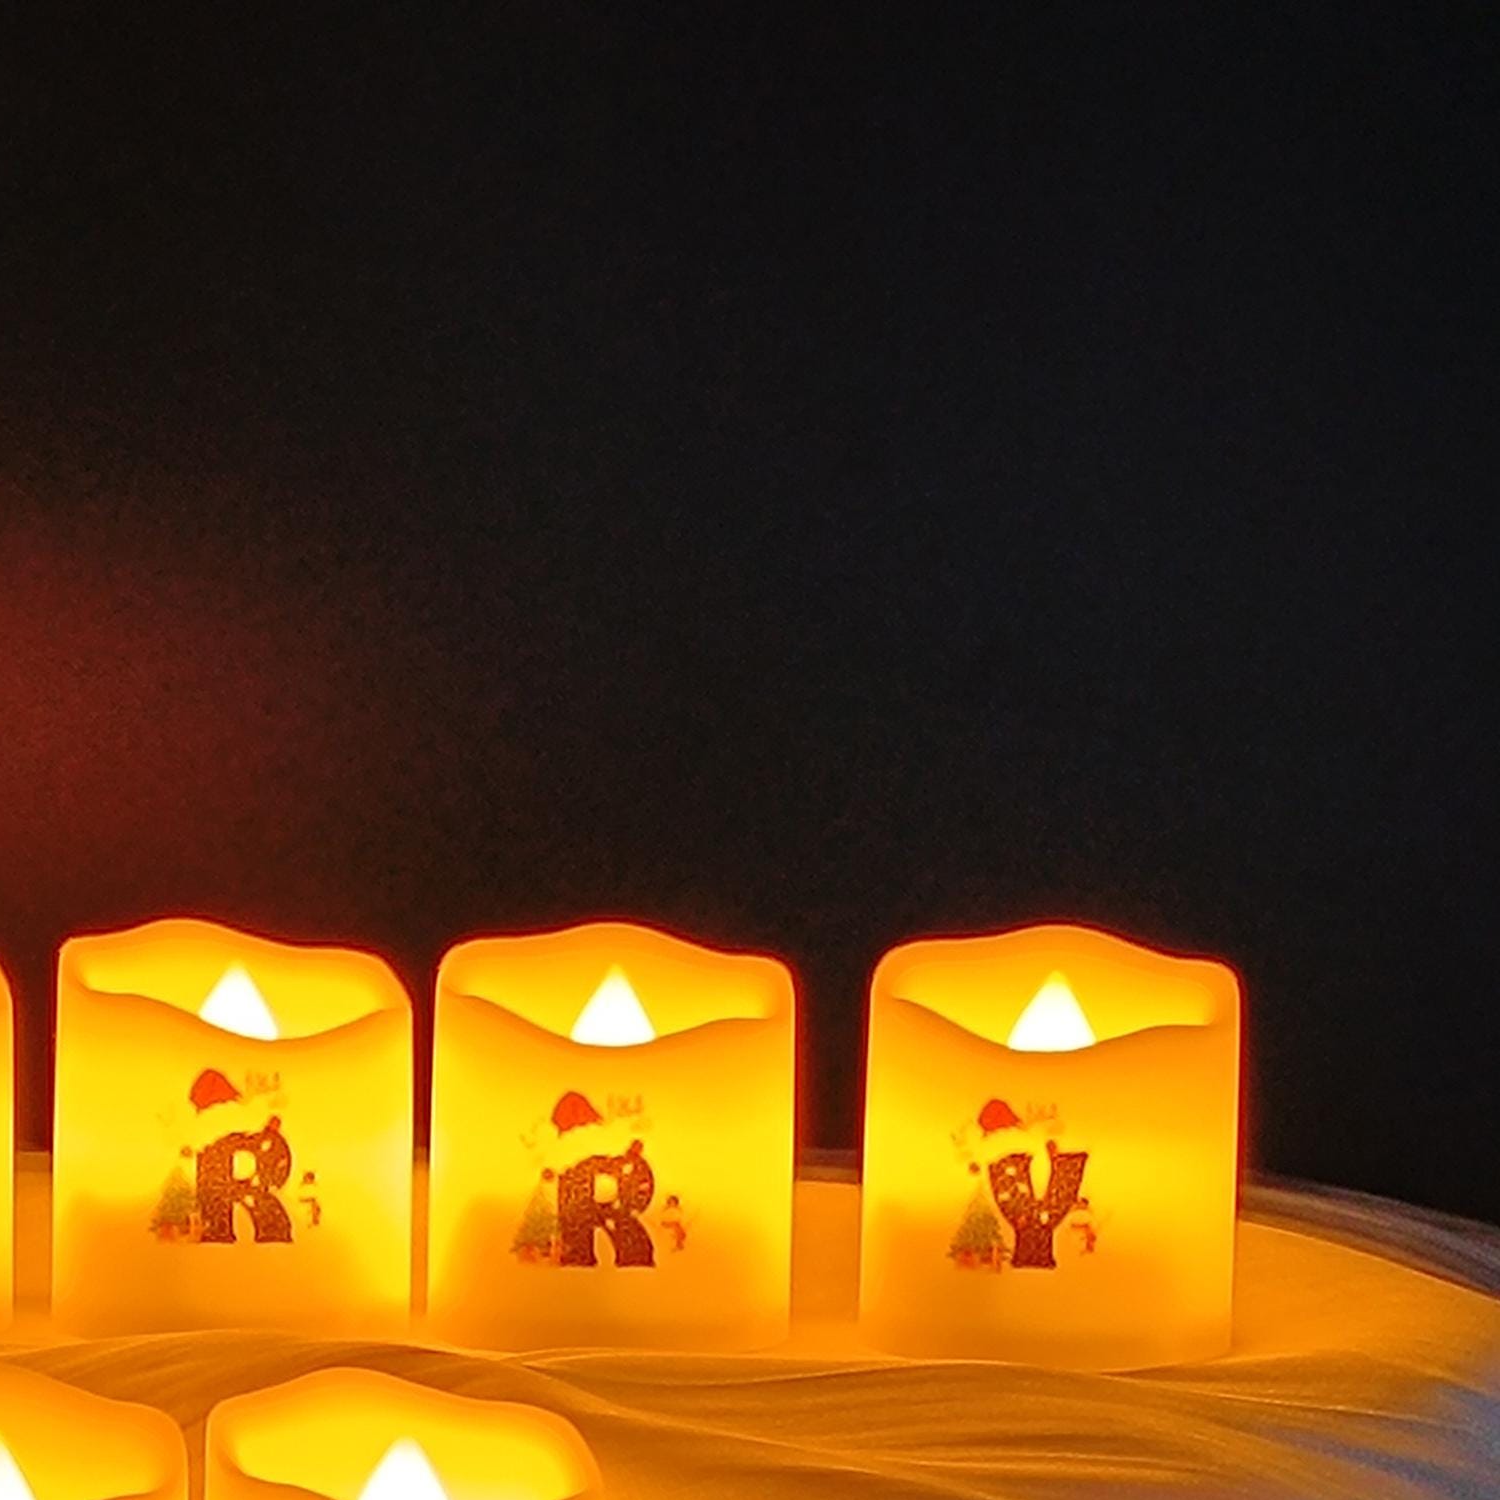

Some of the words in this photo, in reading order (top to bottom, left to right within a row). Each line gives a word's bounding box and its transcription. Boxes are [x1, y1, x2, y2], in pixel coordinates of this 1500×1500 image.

[195, 1126, 294, 1244] R
[556, 1151, 655, 1268] R
[987, 1150, 1090, 1270] Y
